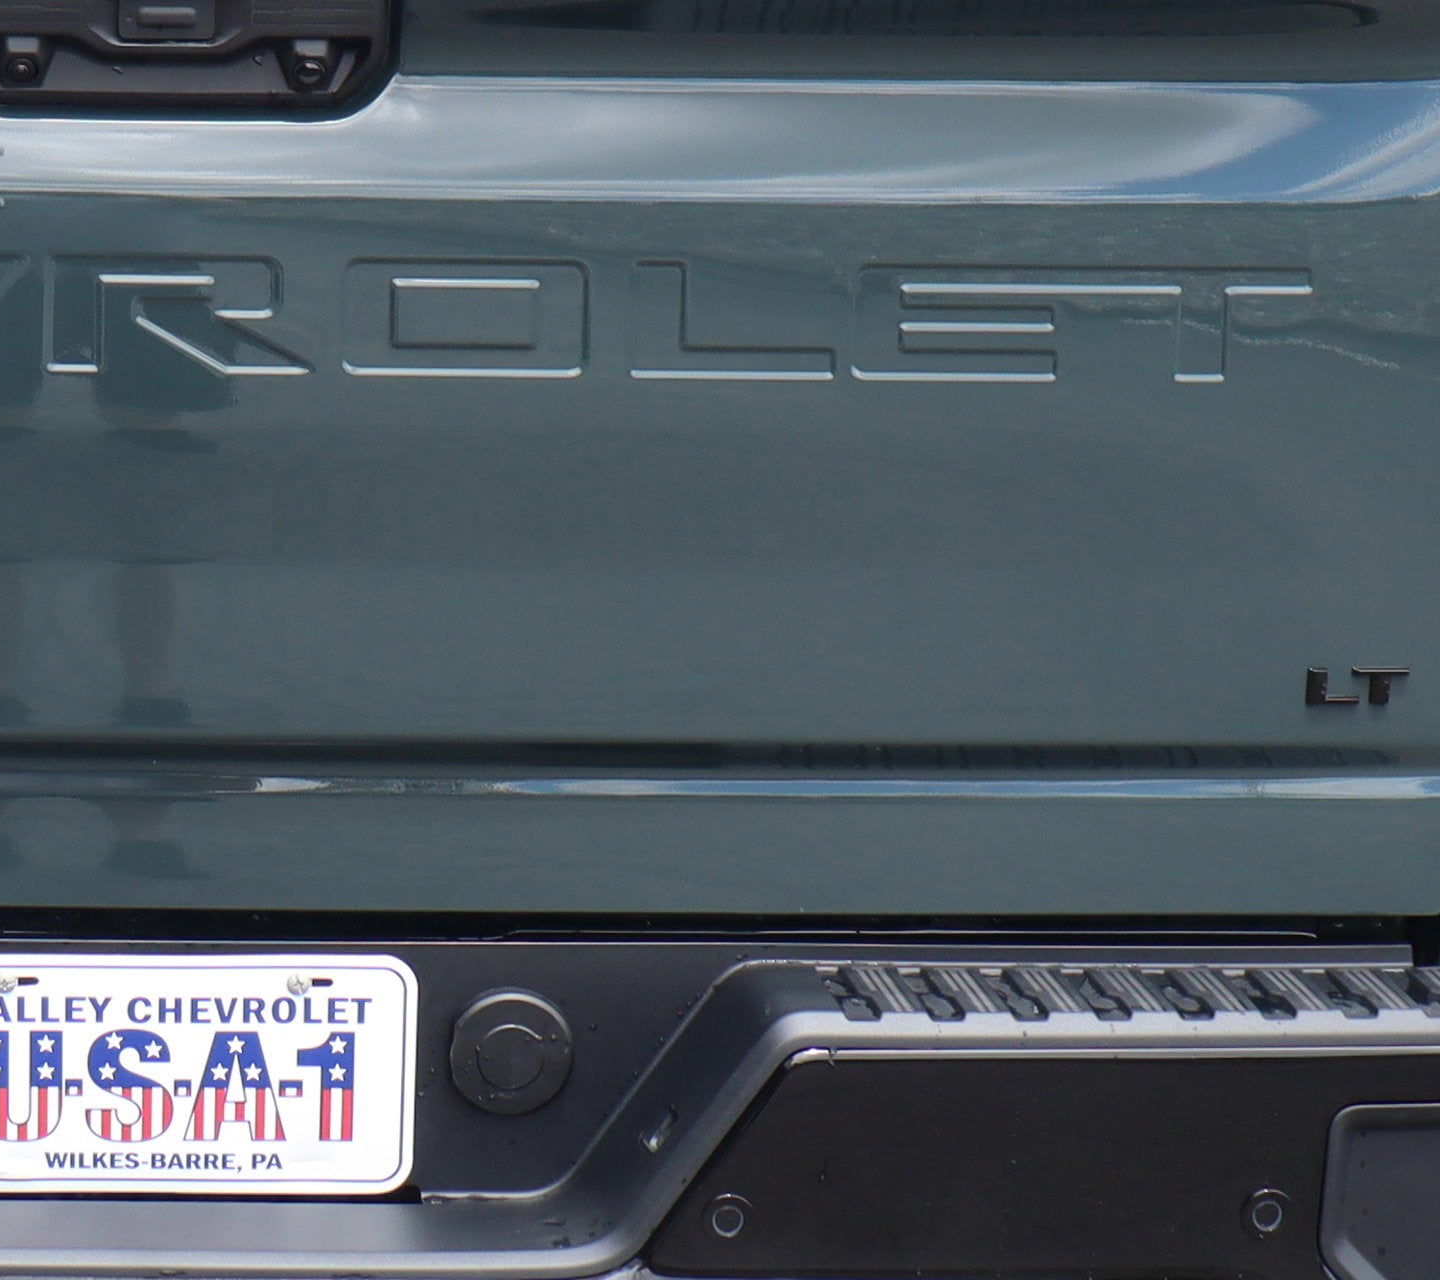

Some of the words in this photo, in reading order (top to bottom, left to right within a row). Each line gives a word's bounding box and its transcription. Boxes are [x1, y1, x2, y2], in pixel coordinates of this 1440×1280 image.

[1305, 665, 1411, 706] LT
[126, 996, 373, 1024] CHEVROLET
[44, 1151, 243, 1174] WILKES-BARRE,
[251, 1153, 283, 1170] PA
